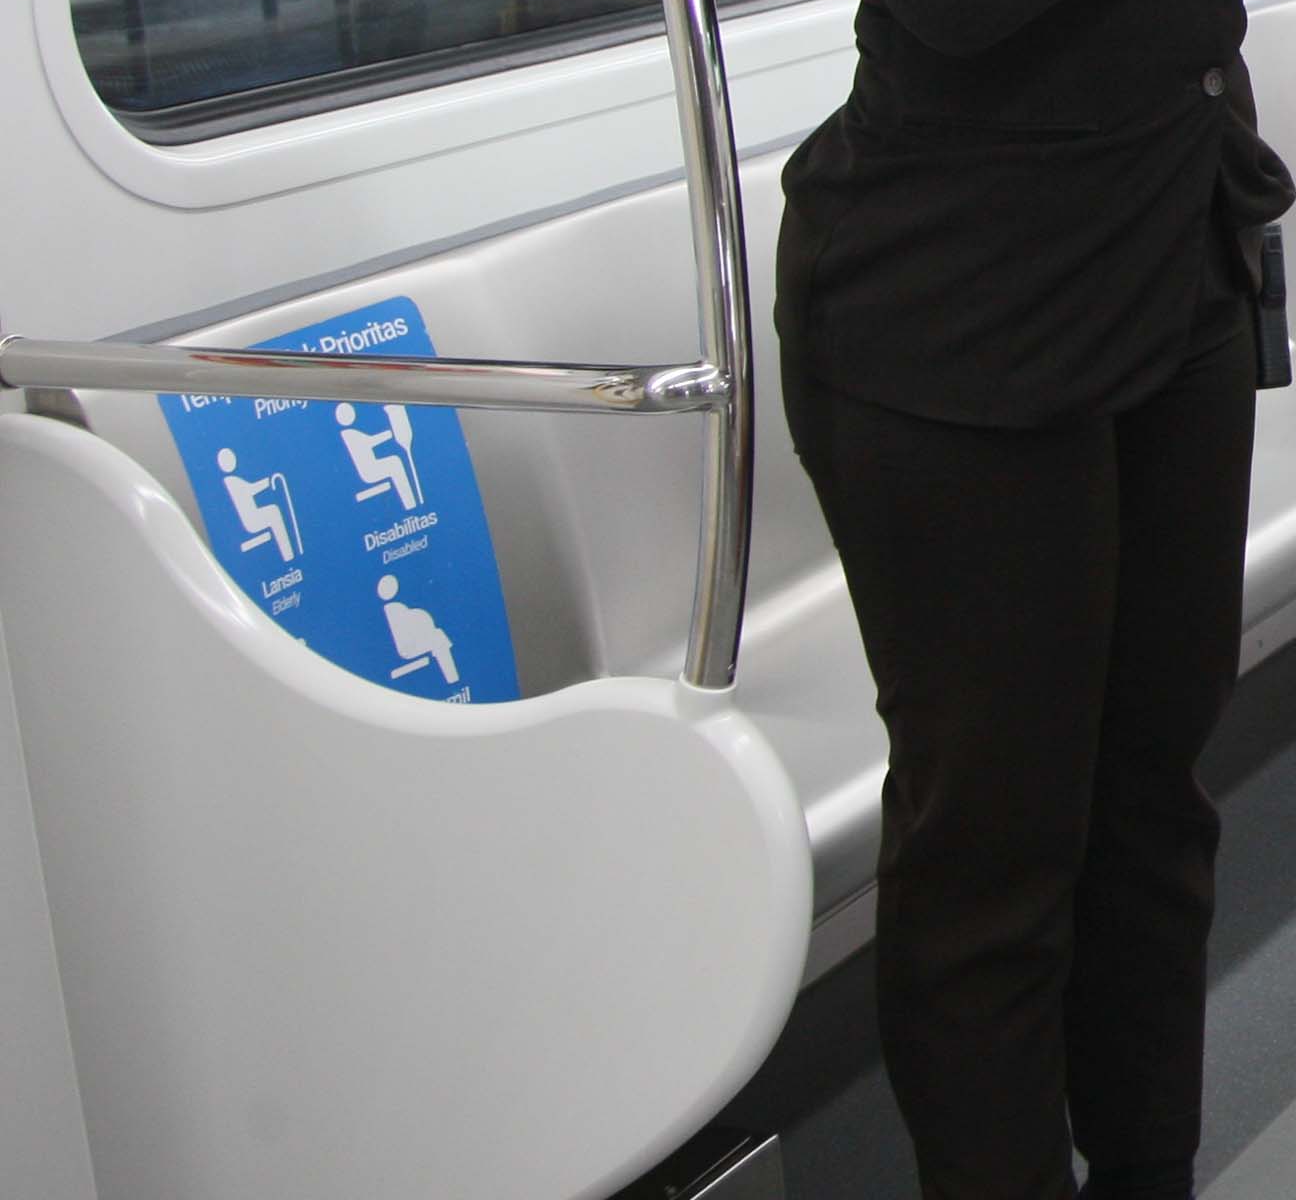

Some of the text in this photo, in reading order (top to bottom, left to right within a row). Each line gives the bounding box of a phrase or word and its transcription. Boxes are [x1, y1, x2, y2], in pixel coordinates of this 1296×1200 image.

[319, 317, 409, 354] Prioritas
[364, 511, 439, 552] Disabilitas
[382, 535, 428, 565] Disabled
[261, 567, 304, 599] Lansia
[272, 592, 302, 616] Elderly
